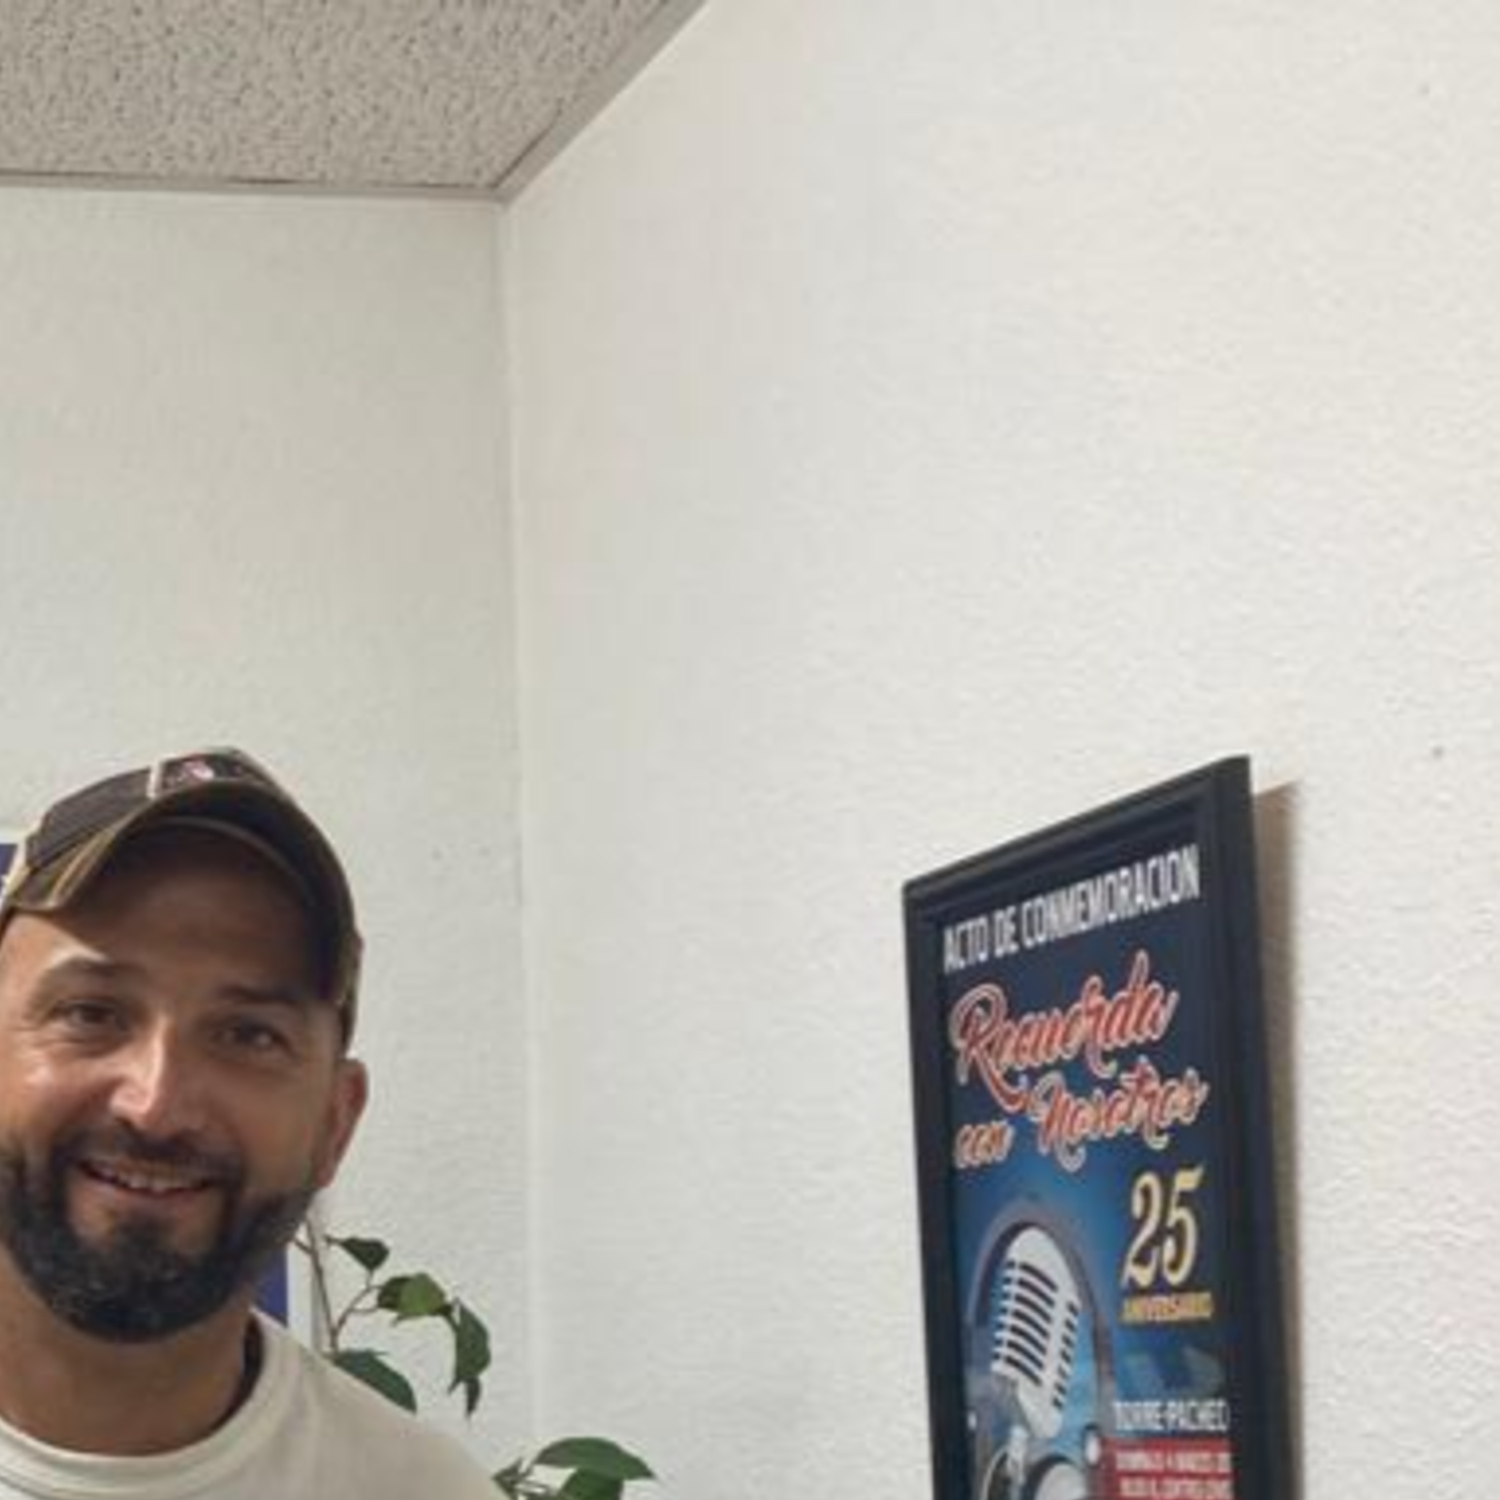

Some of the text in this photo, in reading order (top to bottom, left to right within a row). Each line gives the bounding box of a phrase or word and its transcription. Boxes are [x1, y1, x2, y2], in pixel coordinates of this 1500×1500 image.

[943, 844, 1200, 975] ACTO DE CONMEMORACION
[1120, 1167, 1203, 1287] 25
